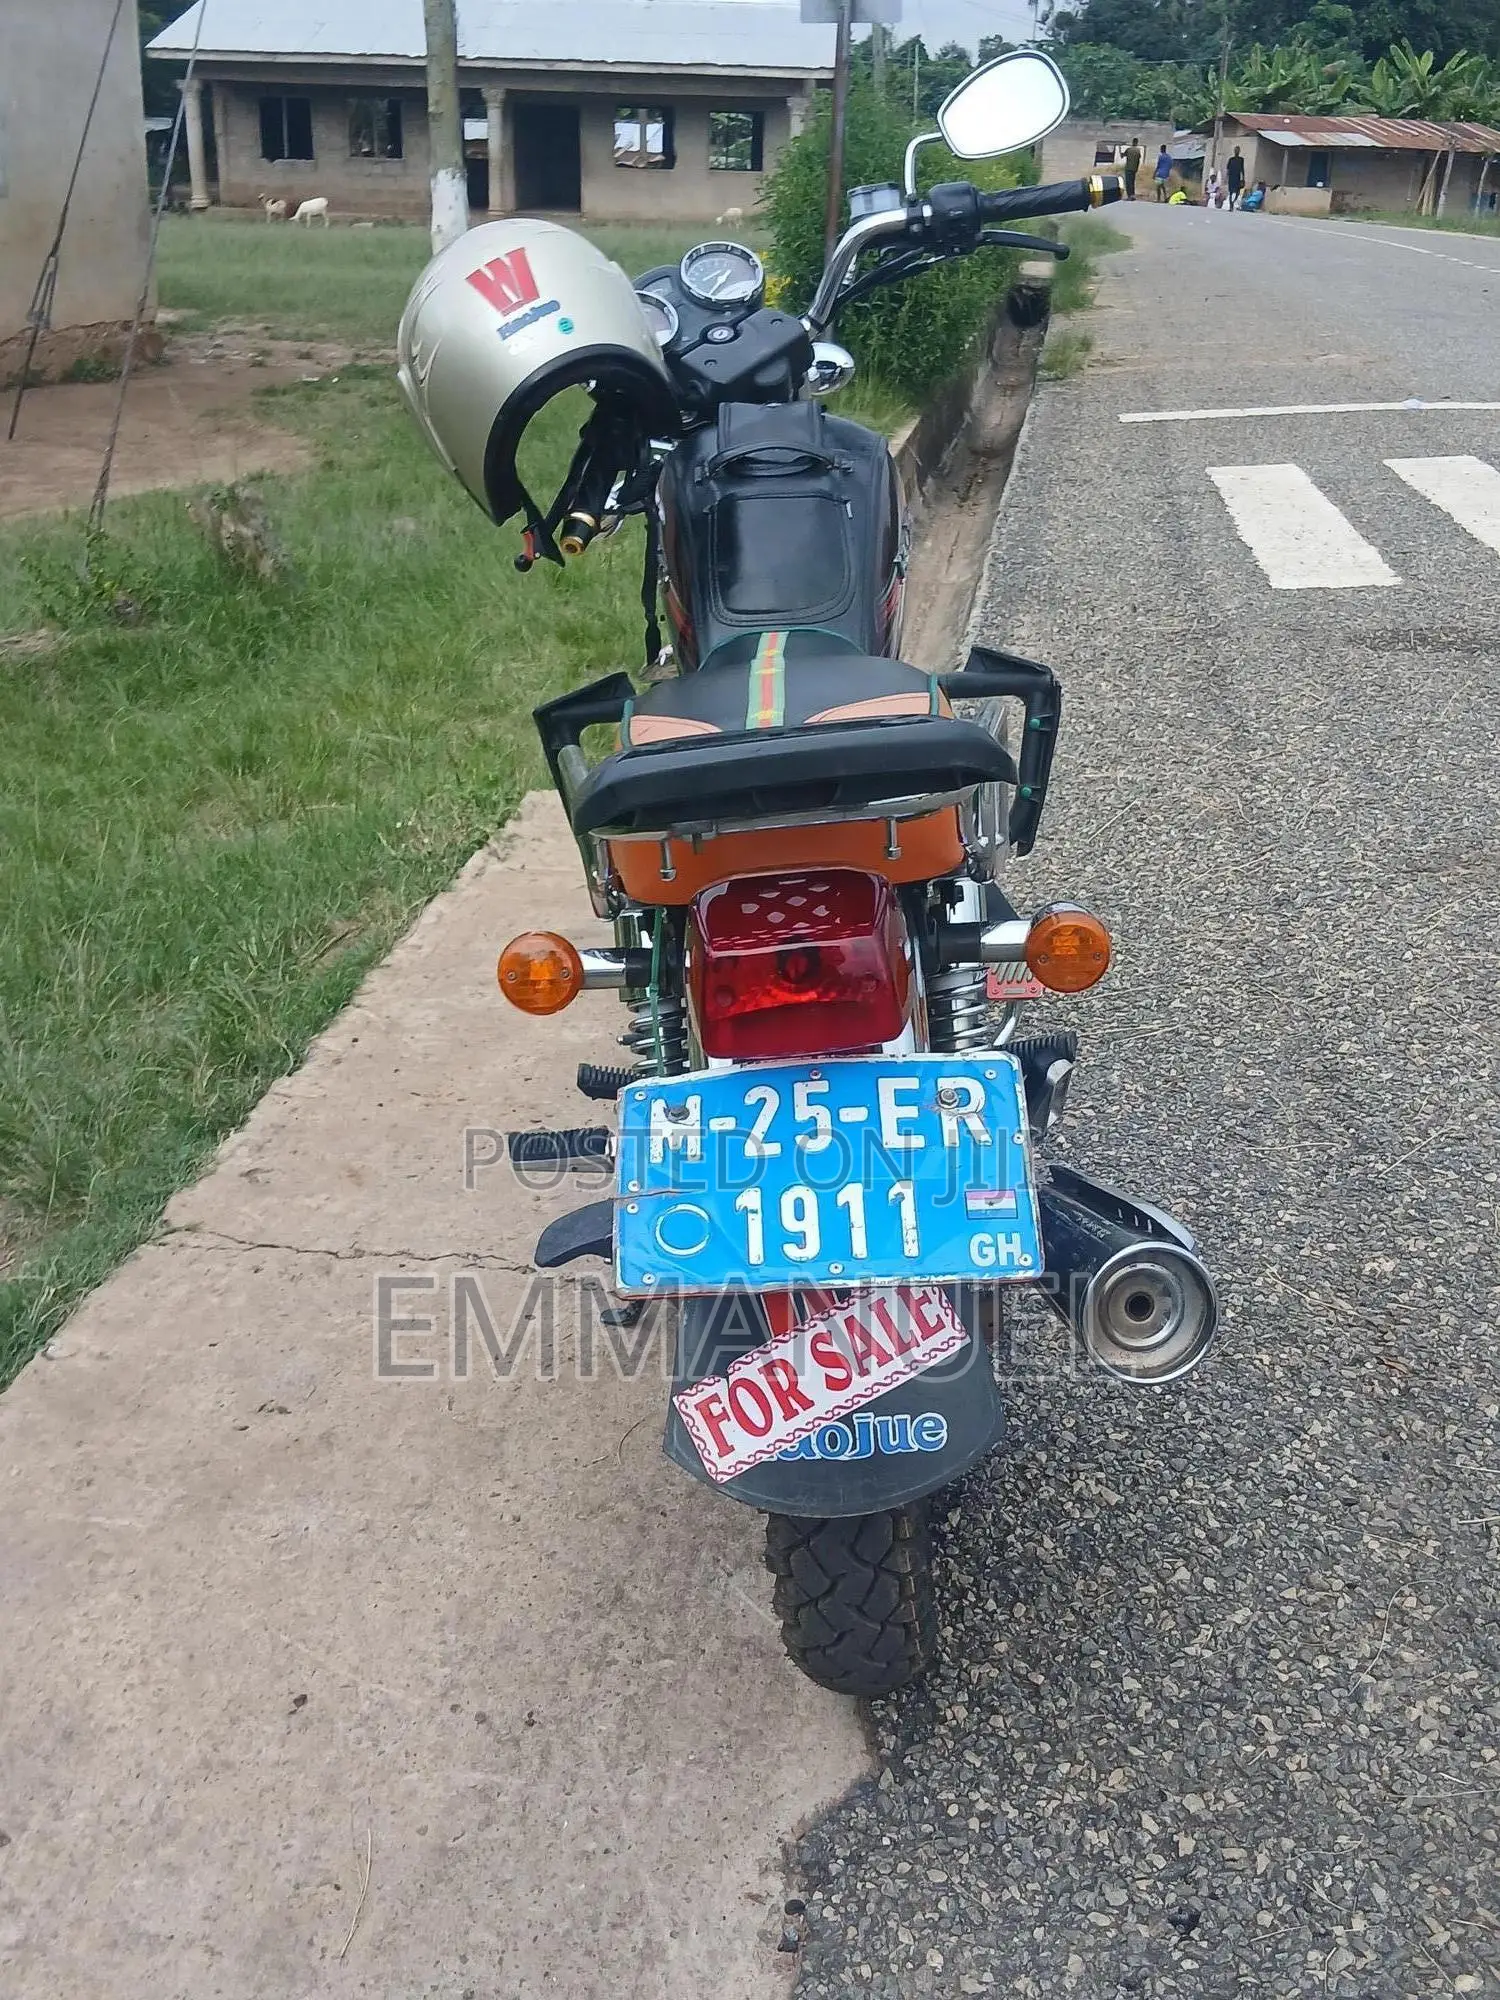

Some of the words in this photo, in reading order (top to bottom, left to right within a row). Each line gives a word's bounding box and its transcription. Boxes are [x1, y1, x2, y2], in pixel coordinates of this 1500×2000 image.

[650, 1076, 993, 1164] M-25-ER
[735, 1180, 921, 1266] 1911
[969, 1232, 1023, 1268] GH
[695, 1358, 815, 1459] FOR
[809, 1286, 946, 1392] SALE
